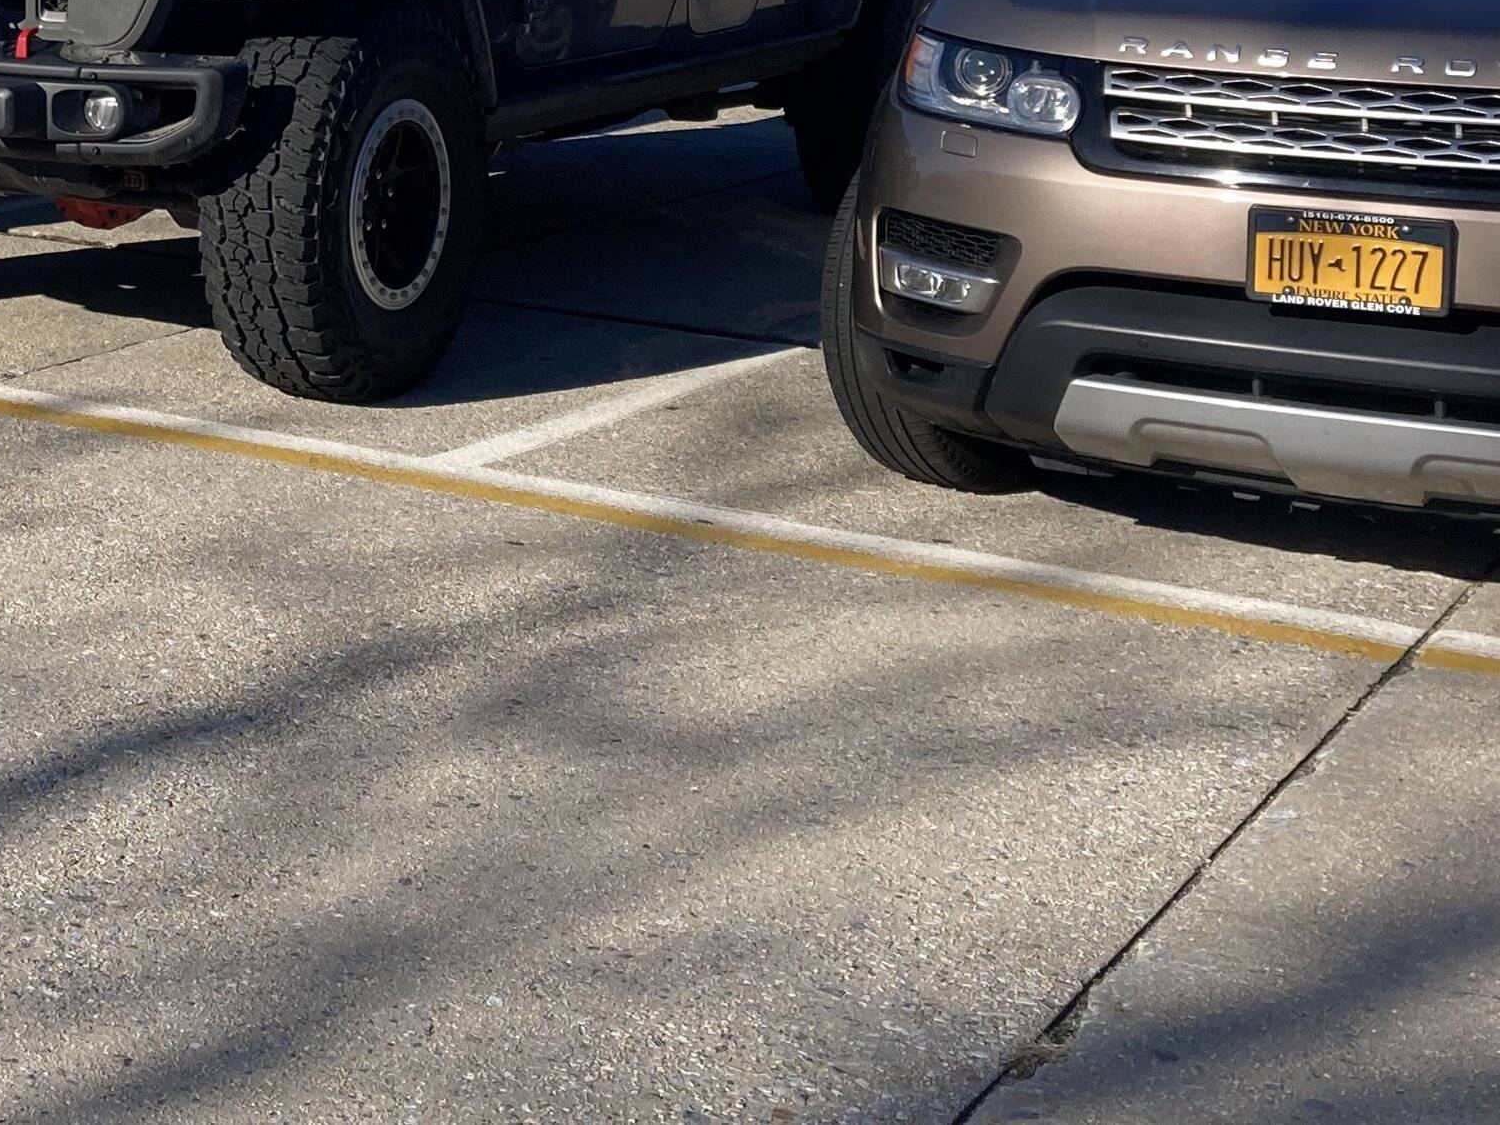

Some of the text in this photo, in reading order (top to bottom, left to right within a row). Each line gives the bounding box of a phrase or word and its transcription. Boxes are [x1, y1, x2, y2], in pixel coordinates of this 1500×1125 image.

[1118, 36, 1500, 76] RANGE RO
[1298, 219, 1400, 239] NEW YORK
[1267, 236, 1429, 294] HUY 1227
[1272, 294, 1421, 316] LAND ROVER GLEN COVE
